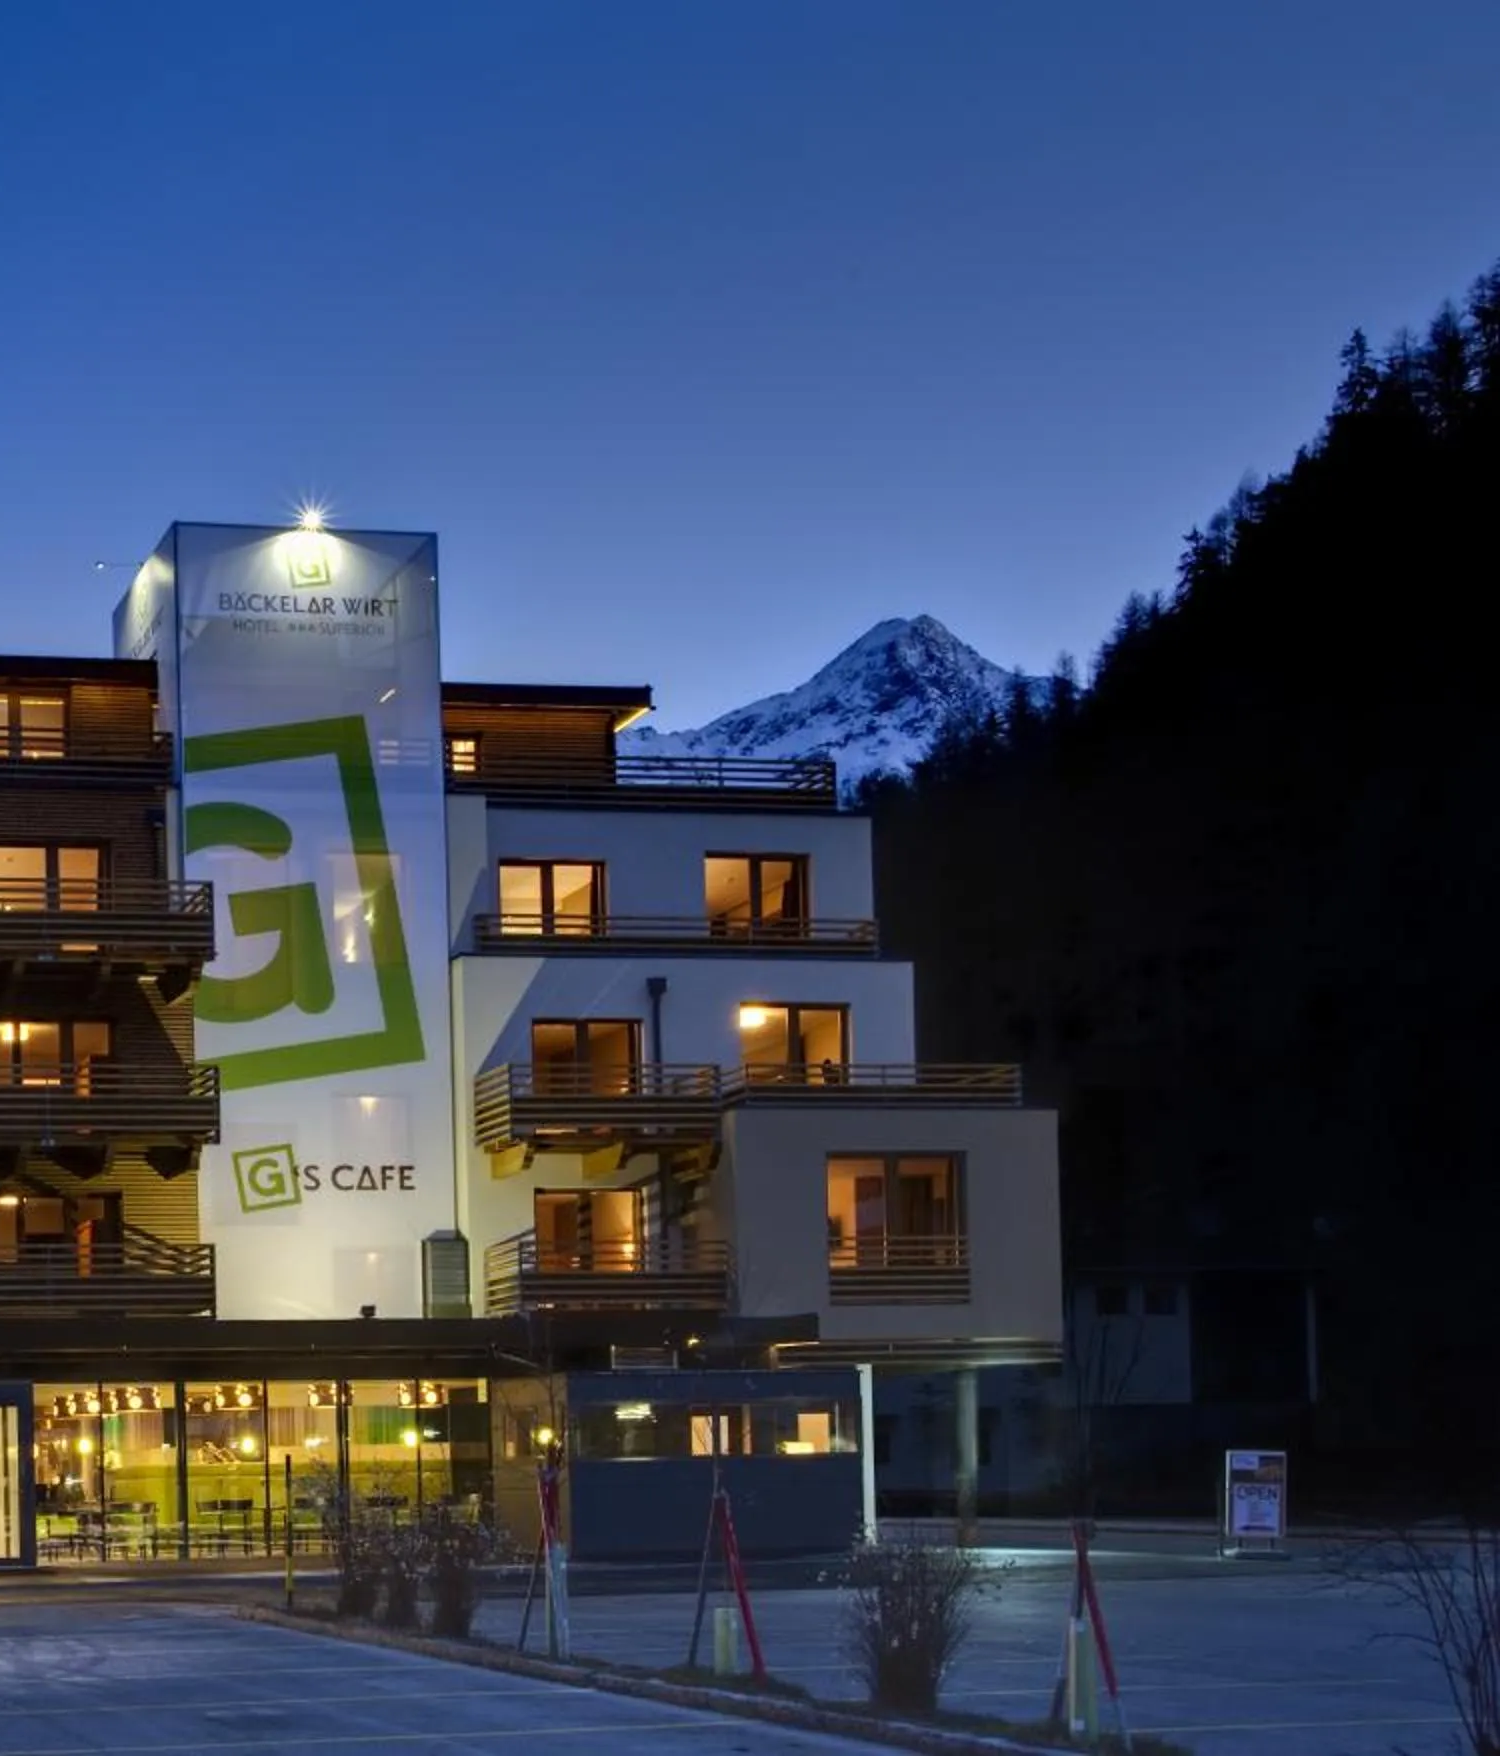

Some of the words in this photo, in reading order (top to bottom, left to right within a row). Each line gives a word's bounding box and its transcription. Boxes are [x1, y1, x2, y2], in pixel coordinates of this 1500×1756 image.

[218, 592, 336, 615] BÄCKELAR
[232, 618, 280, 634] HOTEL
[330, 1164, 416, 1191] CAFE
